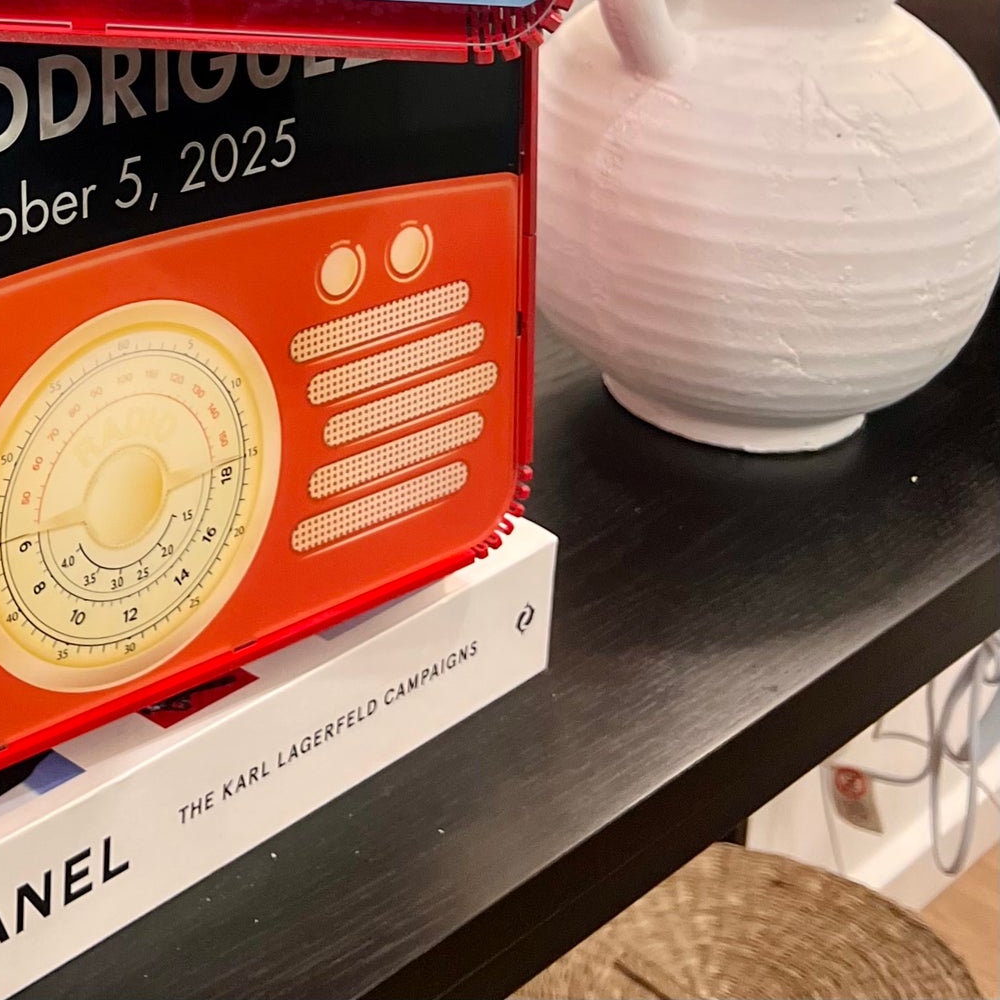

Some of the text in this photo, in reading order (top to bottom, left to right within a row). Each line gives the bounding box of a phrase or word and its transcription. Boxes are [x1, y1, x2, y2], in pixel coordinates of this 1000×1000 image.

[114, 155, 159, 212] 5,
[179, 117, 297, 194] 2025
[231, 377, 242, 389] 10
[247, 446, 258, 457] 15
[0, 452, 14, 466] 50
[234, 525, 246, 538] 20
[33, 581, 46, 595] 8
[69, 609, 86, 626] 10
[123, 607, 138, 623] 12
[173, 568, 190, 586] 14
[202, 526, 217, 543] 16
[221, 466, 233, 485] 18
[189, 596, 201, 608] 25
[6, 611, 19, 623] 40
[124, 642, 136, 654] 30
[56, 649, 69, 661] 35
[178, 640, 479, 824] THE KARL LAGERFELD CAMPAIGNS
